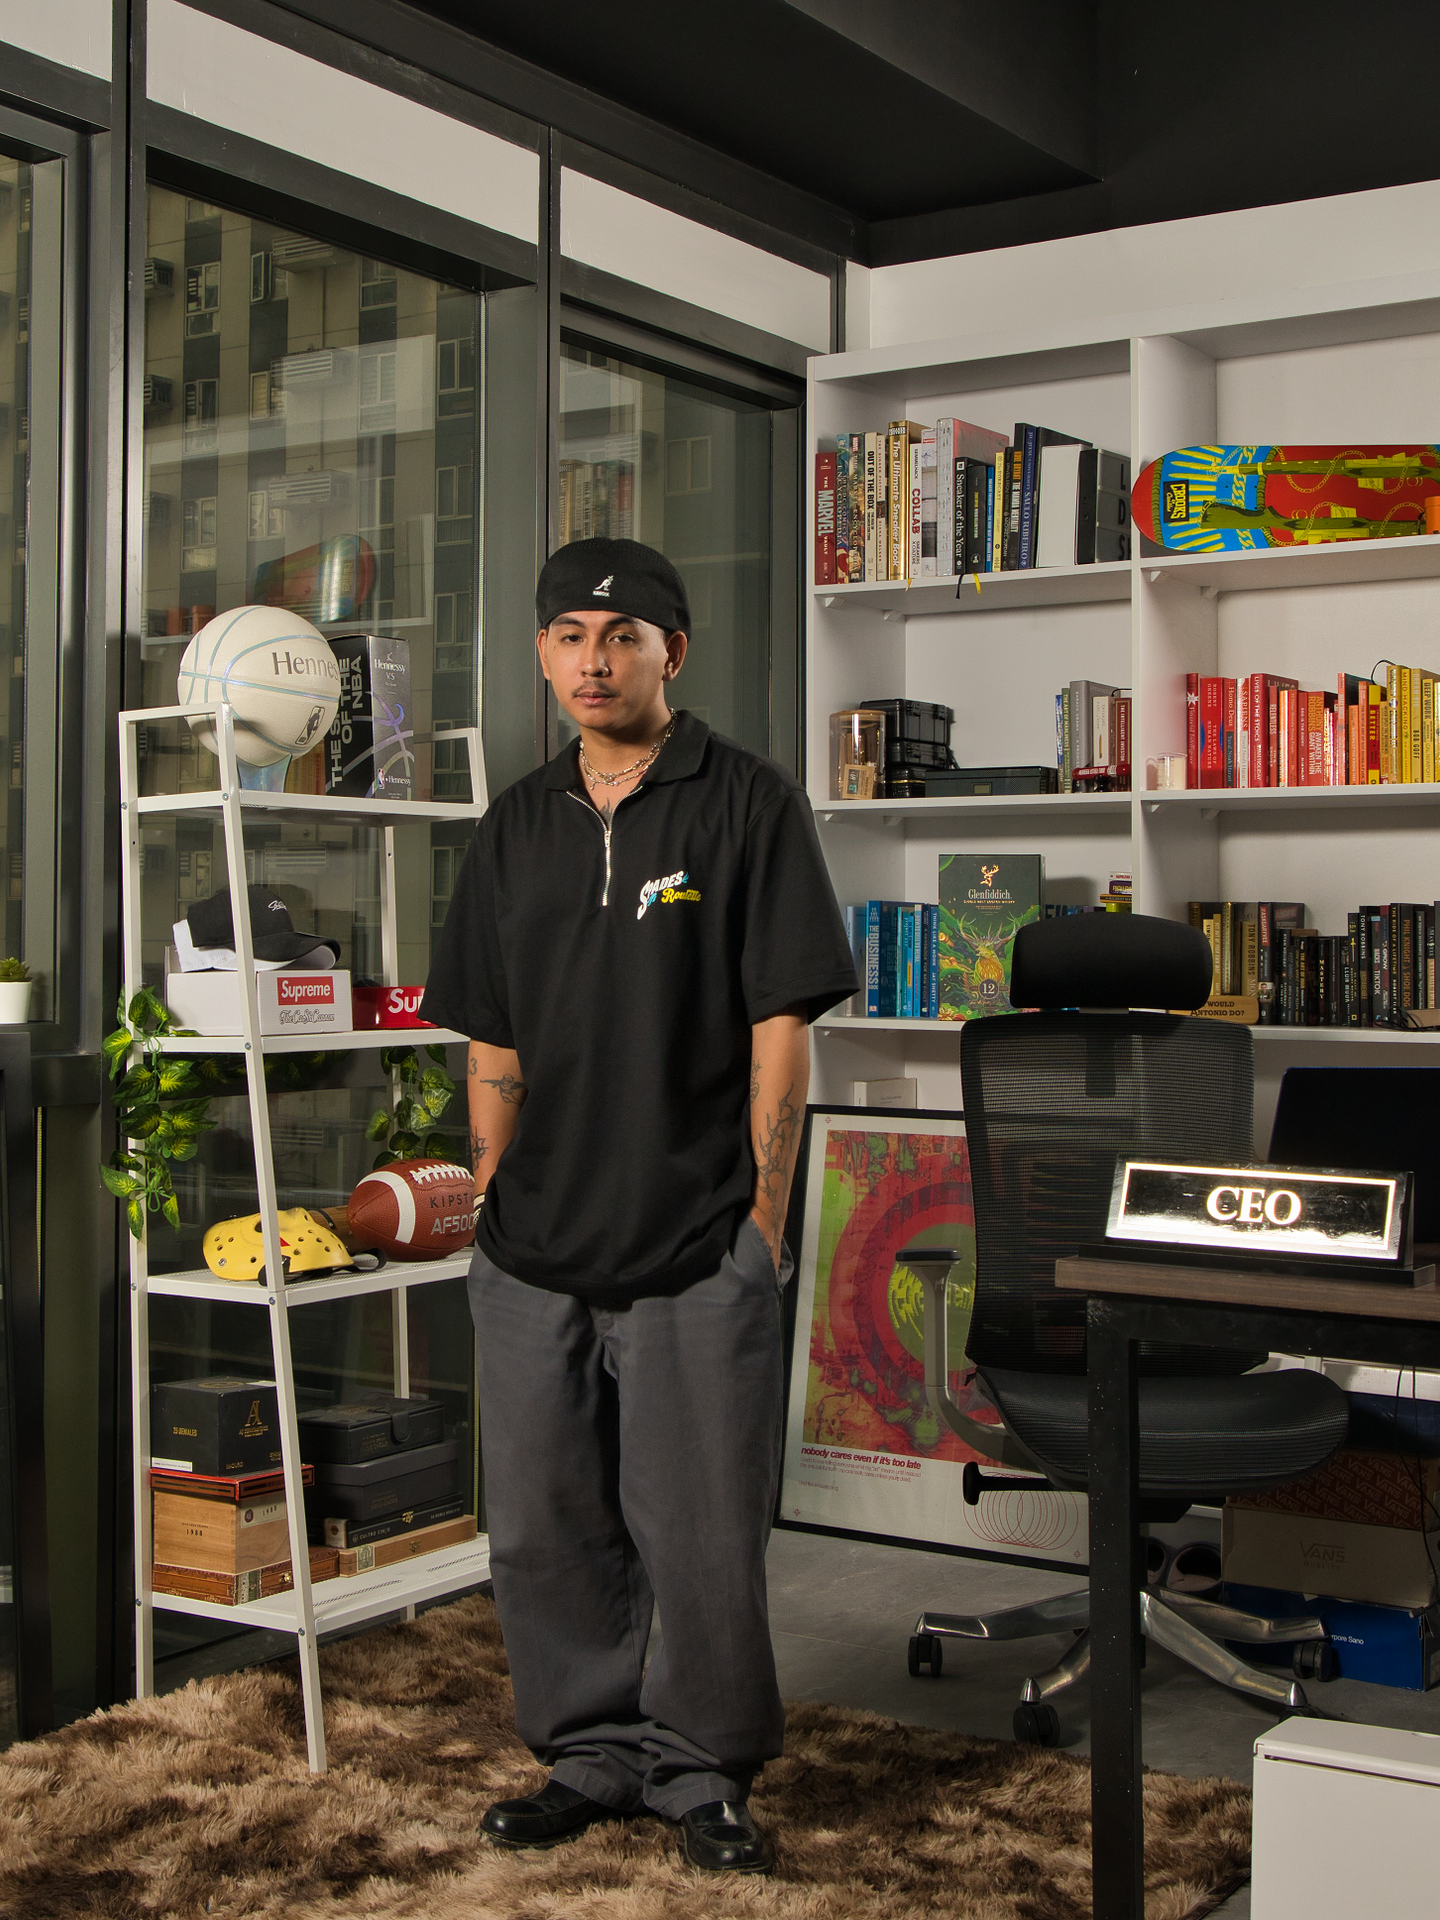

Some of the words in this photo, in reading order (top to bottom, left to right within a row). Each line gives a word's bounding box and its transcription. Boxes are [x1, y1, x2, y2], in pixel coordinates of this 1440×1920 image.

[867, 451, 875, 466] OUT
[892, 440, 901, 458] The
[867, 467, 875, 477] OF
[892, 460, 901, 501] Ultimate
[867, 478, 875, 493] THE
[956, 474, 964, 509] Sneaker
[867, 494, 875, 510] BOX
[912, 488, 921, 534] COLLAB
[1023, 492, 1031, 519] SAULO
[1169, 483, 1186, 519] CROOKS
[818, 489, 834, 536] MARVEL
[892, 503, 901, 542] Sneaker
[956, 518, 964, 531] the
[956, 535, 964, 557] Year
[1021, 521, 1030, 560] RIBEIRO
[892, 543, 901, 567] Book
[272, 651, 340, 681] Hennes
[374, 658, 406, 674] Hennessy
[339, 657, 351, 707] THE
[350, 655, 364, 709] NBA
[1254, 694, 1260, 703] OF
[341, 711, 353, 744] OF
[331, 740, 343, 788] THE
[1213, 756, 1217, 764] OF
[388, 775, 411, 786] Hennessy
[661, 887, 702, 904] Roulette
[968, 888, 1011, 900] Glenfiddich
[869, 932, 879, 984] BUSINESS
[281, 980, 330, 1003] Supreme
[982, 983, 995, 995] 12
[1190, 1009, 1228, 1017] ANTONIO
[429, 1193, 475, 1209] KIPST
[1206, 1185, 1302, 1225] CEO
[172, 1426, 178, 1435] 25
[801, 1447, 829, 1458] nobody
[830, 1450, 852, 1460] cares
[853, 1453, 872, 1463] even
[873, 1455, 879, 1463] if
[879, 1456, 890, 1466] it's
[892, 1458, 905, 1467] too
[906, 1460, 921, 1470] late
[1368, 1457, 1394, 1477] VANS
[1328, 1462, 1354, 1483] VANS
[1336, 1481, 1362, 1504] VANS
[1376, 1475, 1402, 1498] VANS
[1276, 1489, 1302, 1512] VANS
[1296, 1487, 1321, 1509] VANS
[263, 1505, 277, 1517] 1988
[1364, 1499, 1390, 1522] VANS
[186, 1529, 203, 1537] 1988
[359, 1530, 376, 1541] CUATRO
[1299, 1541, 1345, 1564] VANS
[1303, 1561, 1341, 1573] QUALITY
[1348, 1635, 1365, 1645] Sano
